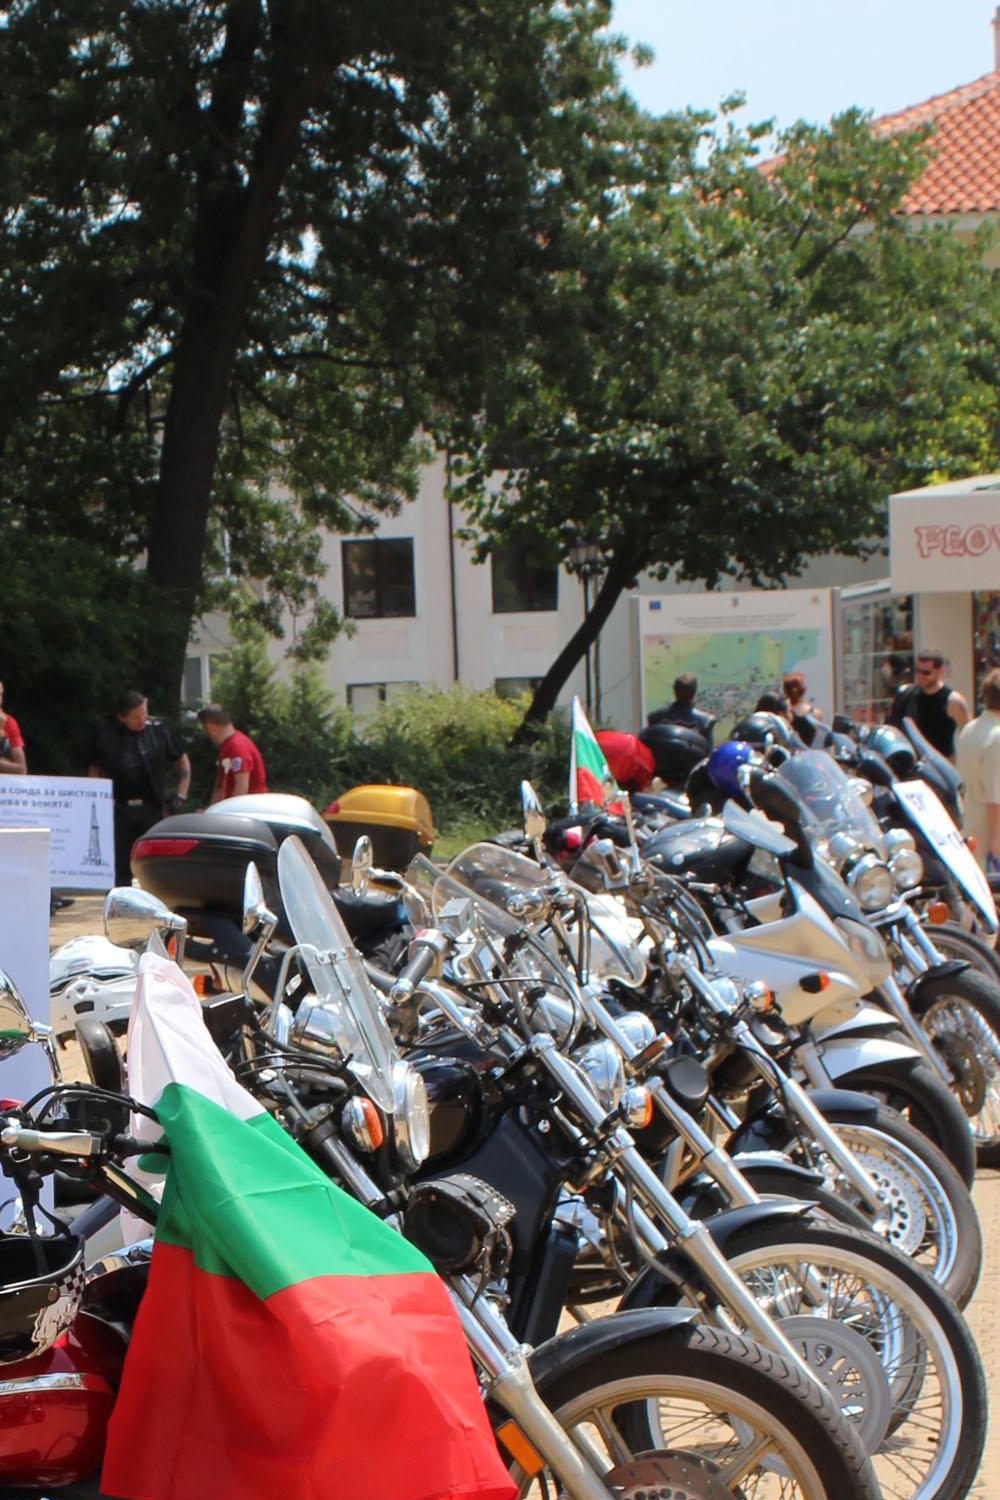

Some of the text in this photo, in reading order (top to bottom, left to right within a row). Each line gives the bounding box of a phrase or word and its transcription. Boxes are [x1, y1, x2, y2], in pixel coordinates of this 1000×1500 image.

[914, 524, 1000, 558] FLO
[8, 787, 41, 797] сонда
[44, 788, 56, 797] за
[58, 789, 98, 798] шистов
